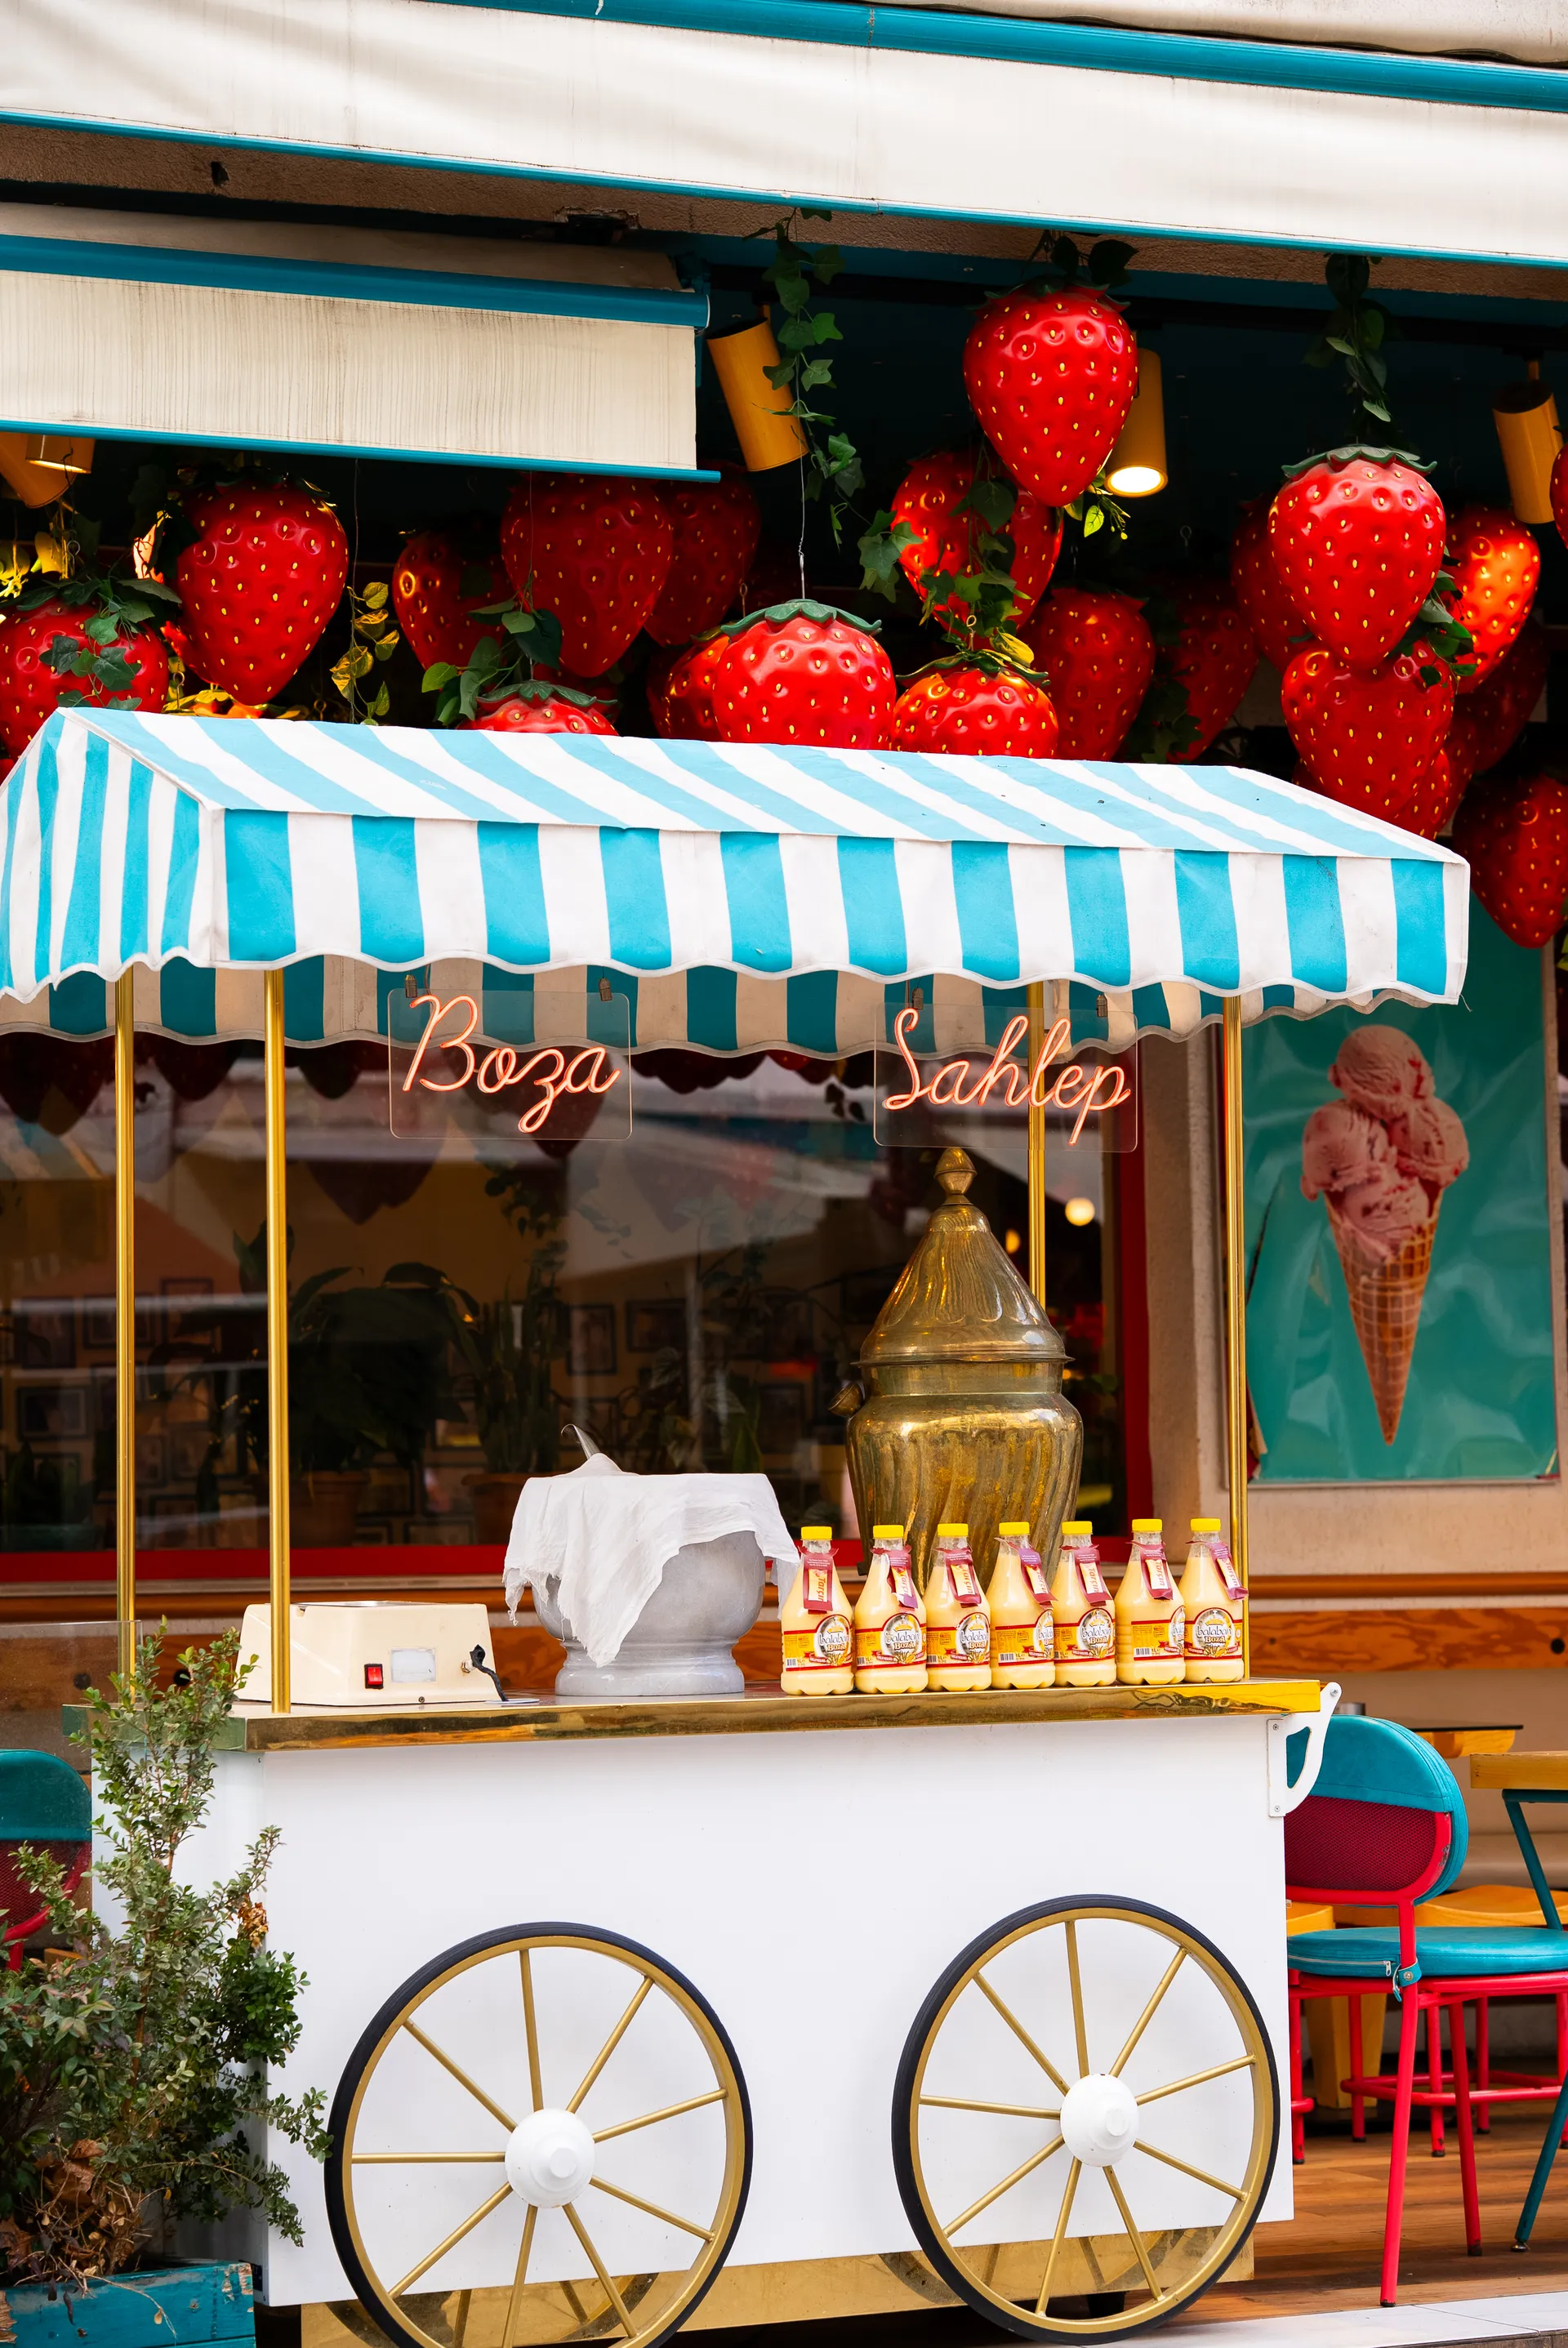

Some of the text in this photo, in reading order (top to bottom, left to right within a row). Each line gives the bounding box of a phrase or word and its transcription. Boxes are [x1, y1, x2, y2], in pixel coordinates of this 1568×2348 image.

[402, 993, 621, 1134] Boza
[881, 1007, 1132, 1147] Sahlep
[1196, 1625, 1232, 1636] balaban
[1205, 1635, 1227, 1643] BOZA
[893, 1641, 915, 1651] BOZA
